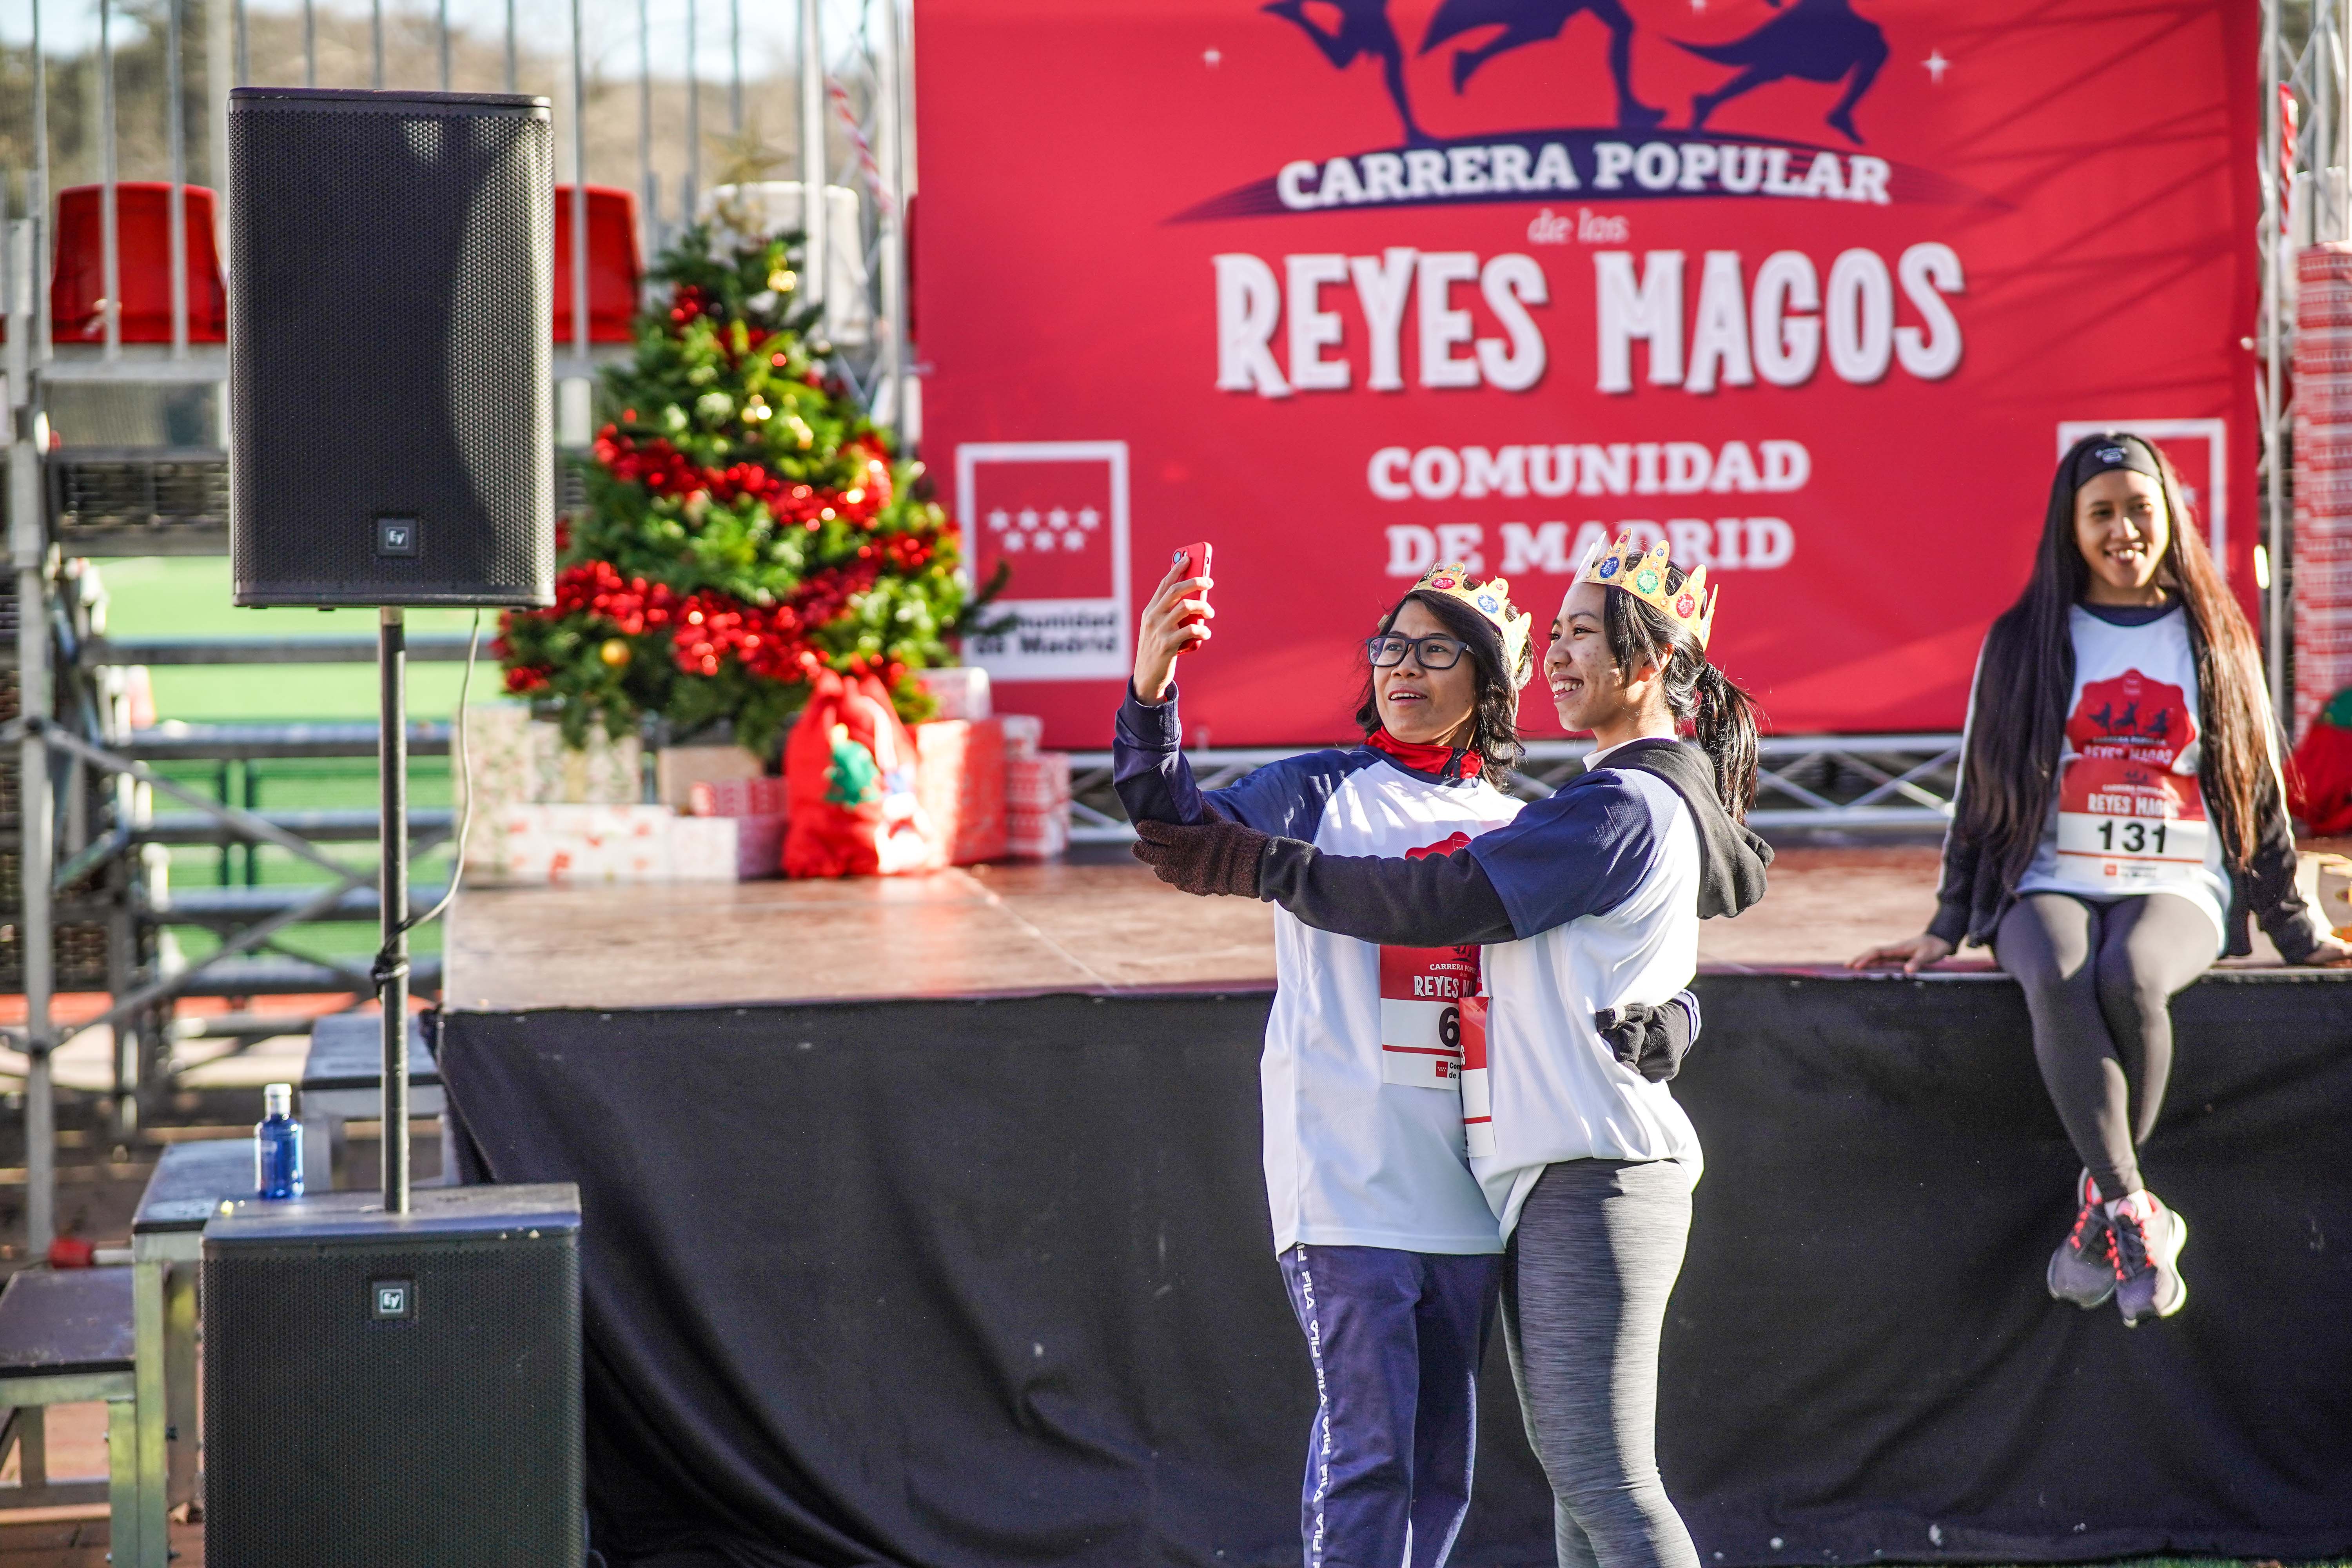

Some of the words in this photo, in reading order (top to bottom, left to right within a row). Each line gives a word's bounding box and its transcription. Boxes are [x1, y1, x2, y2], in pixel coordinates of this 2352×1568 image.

[1276, 143, 1579, 210] CARRERA
[1594, 142, 1890, 204] POPULAR
[1526, 207, 1574, 245] de
[1577, 206, 1630, 244] los
[1212, 247, 1548, 397] REYES
[1593, 242, 1964, 394] MAGOS
[1367, 439, 1811, 501] COMUNIDAD
[1385, 523, 1484, 577] DE
[2087, 793, 2131, 815] REYES
[2098, 819, 2166, 854] 131
[1414, 975, 1459, 999] REYES
[1439, 1007, 1460, 1047] 6
[1301, 1270, 1315, 1310] FILA
[1309, 1319, 1321, 1358] FILA
[1316, 1368, 1328, 1406] FILA
[1321, 1416, 1331, 1455] FILA
[1312, 1463, 1327, 1503] FILA
[1312, 1512, 1324, 1553] FILA
